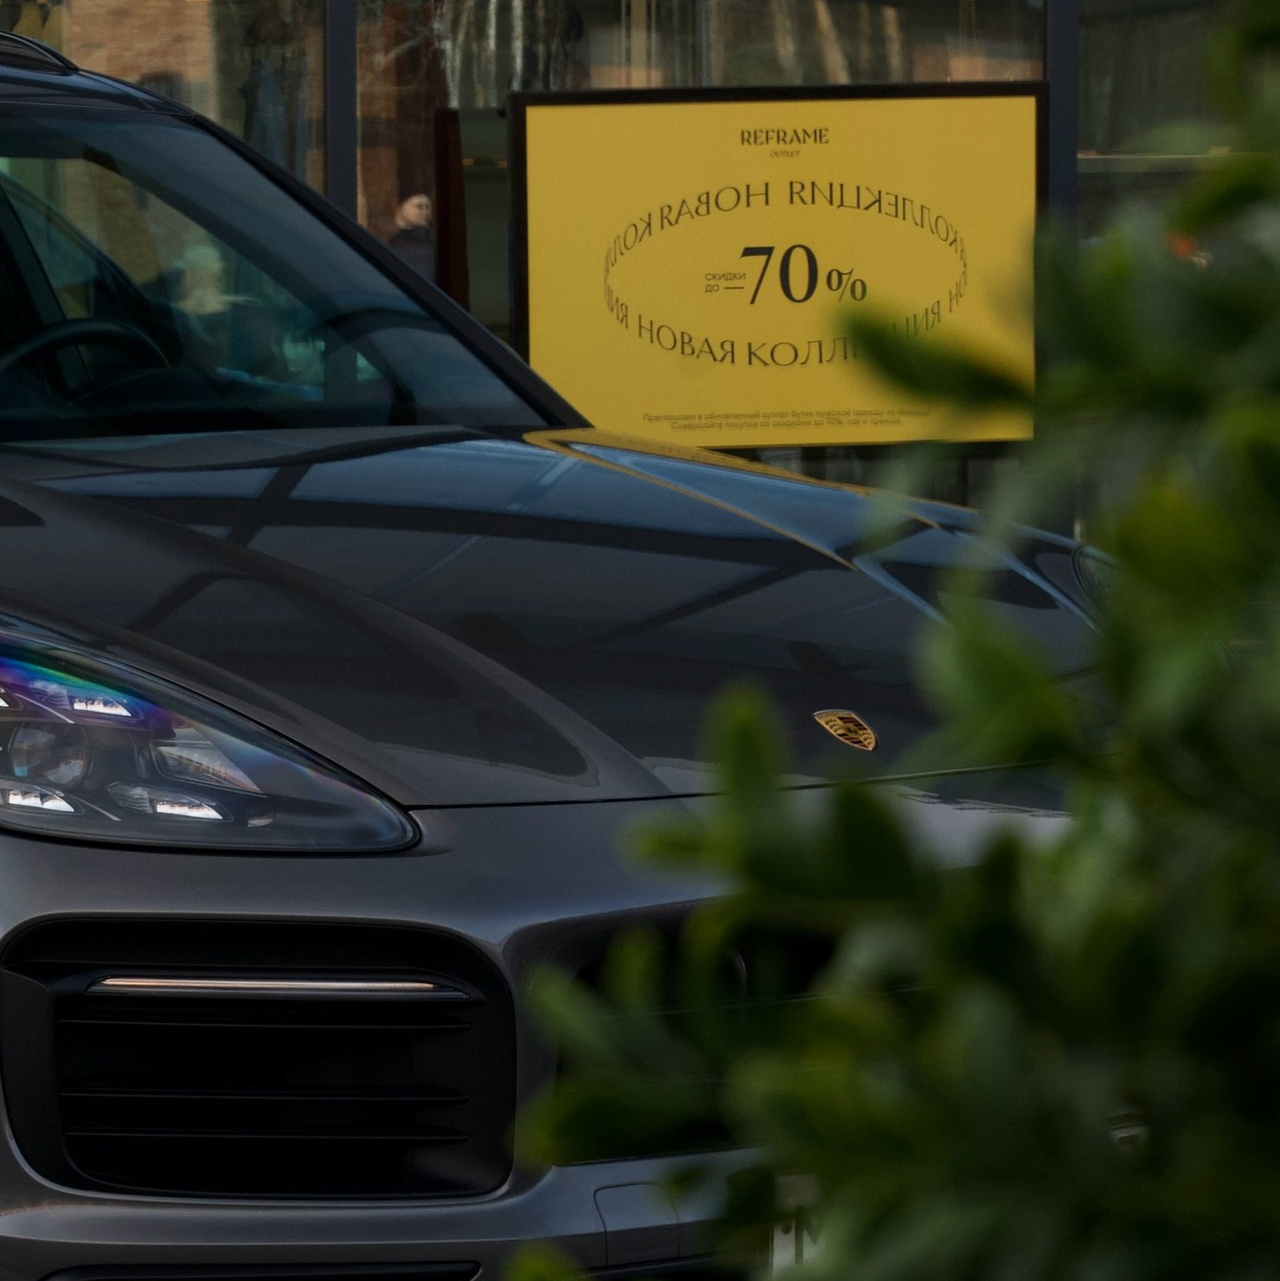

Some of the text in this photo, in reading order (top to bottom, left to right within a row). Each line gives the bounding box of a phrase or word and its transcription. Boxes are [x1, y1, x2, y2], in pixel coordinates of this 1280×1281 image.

[740, 128, 830, 146] REFRAME
[770, 150, 801, 158] OUTLET
[638, 313, 736, 365] НОВАЯ
